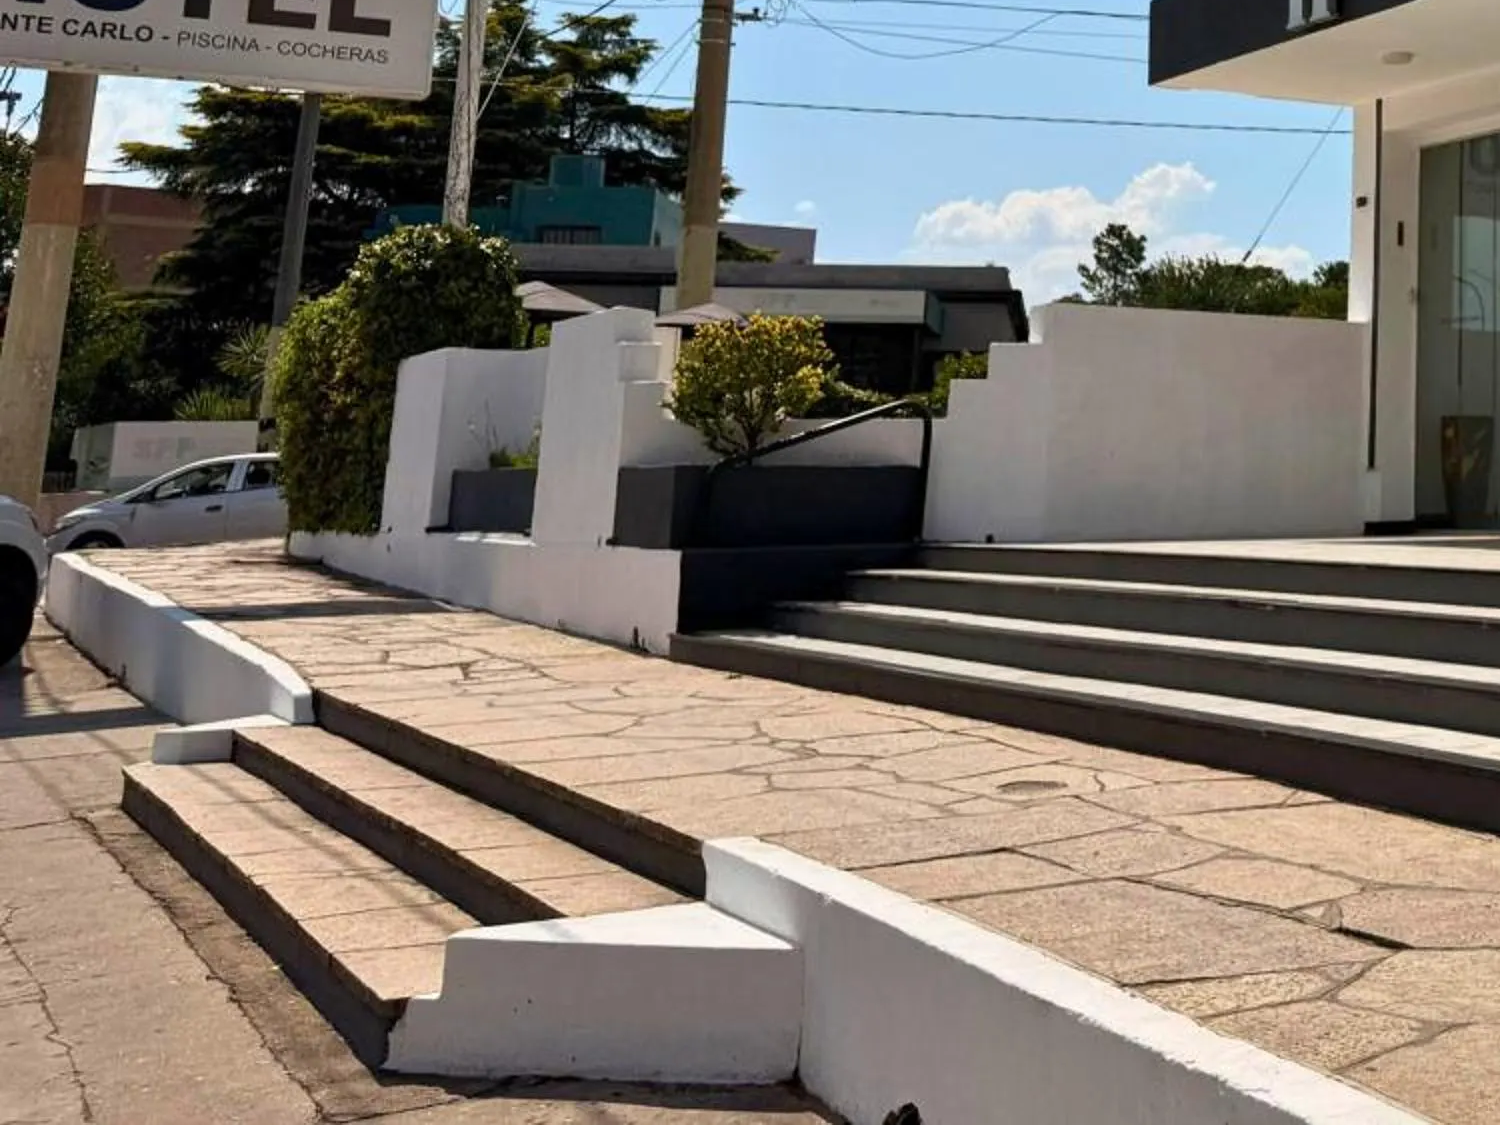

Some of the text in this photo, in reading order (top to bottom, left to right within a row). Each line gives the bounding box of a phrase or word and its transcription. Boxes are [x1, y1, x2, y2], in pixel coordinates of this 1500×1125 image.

[61, 18, 154, 43] CARLO
[177, 30, 260, 53] PISCINA
[276, 40, 389, 64] COCHERAS
